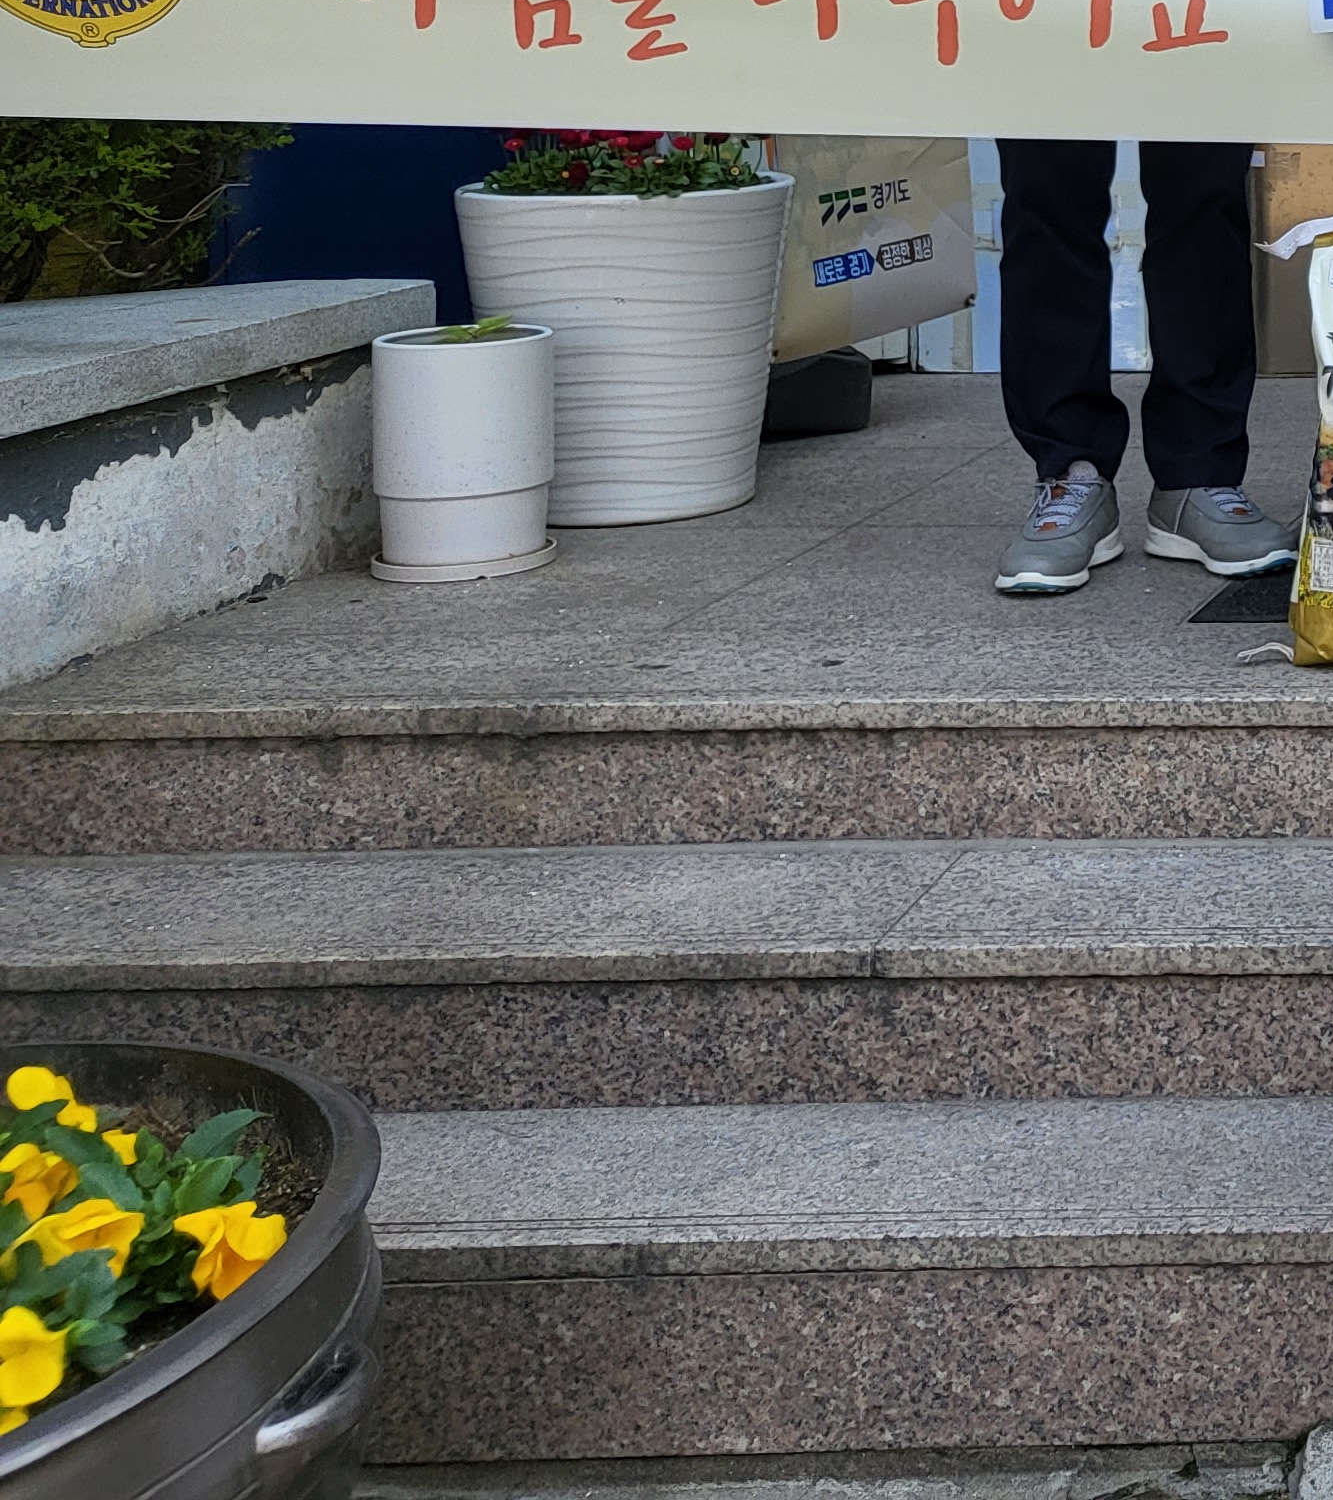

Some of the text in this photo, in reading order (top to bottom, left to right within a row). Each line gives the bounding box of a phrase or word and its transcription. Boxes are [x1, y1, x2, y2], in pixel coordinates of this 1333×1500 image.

[870, 179, 912, 210] 경기도
[814, 236, 933, 286] 새로운 경기 공정한 세상
